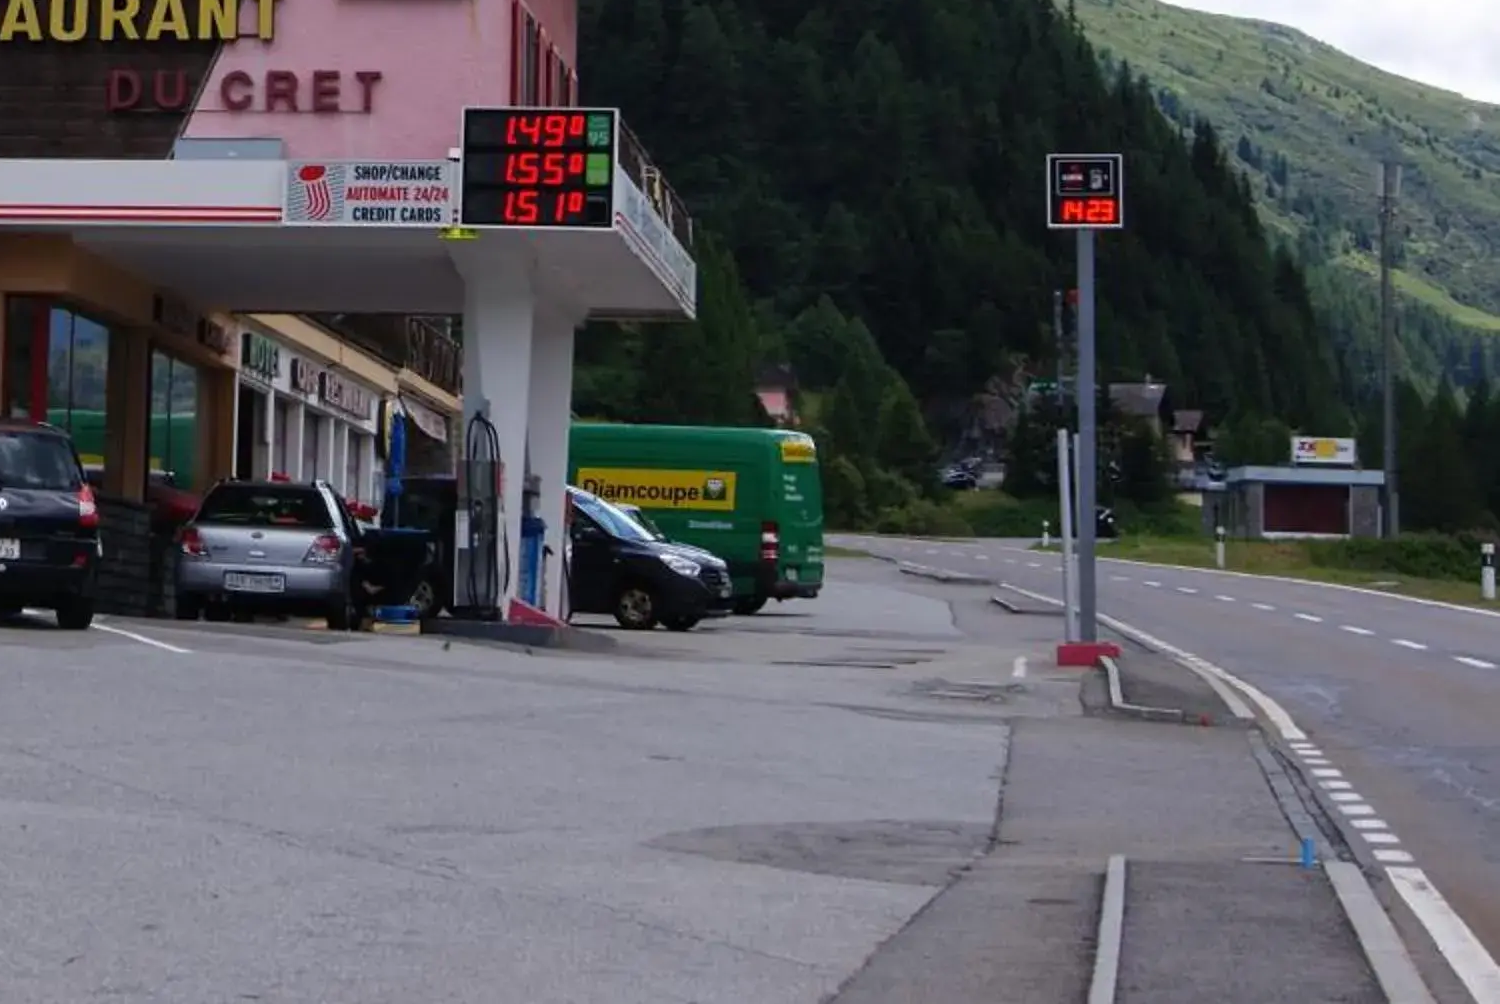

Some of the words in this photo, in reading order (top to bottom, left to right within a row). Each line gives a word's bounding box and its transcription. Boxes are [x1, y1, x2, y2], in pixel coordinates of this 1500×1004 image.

[105, 68, 191, 112] DU
[220, 69, 383, 113] CRET
[354, 164, 442, 181] SHOP/CHANGE
[346, 185, 411, 201] AUTOMATE
[412, 185, 450, 203] 24/24
[352, 207, 397, 222] CREDIT
[400, 207, 442, 222] CARDS
[583, 478, 699, 506] Diamcoupe
